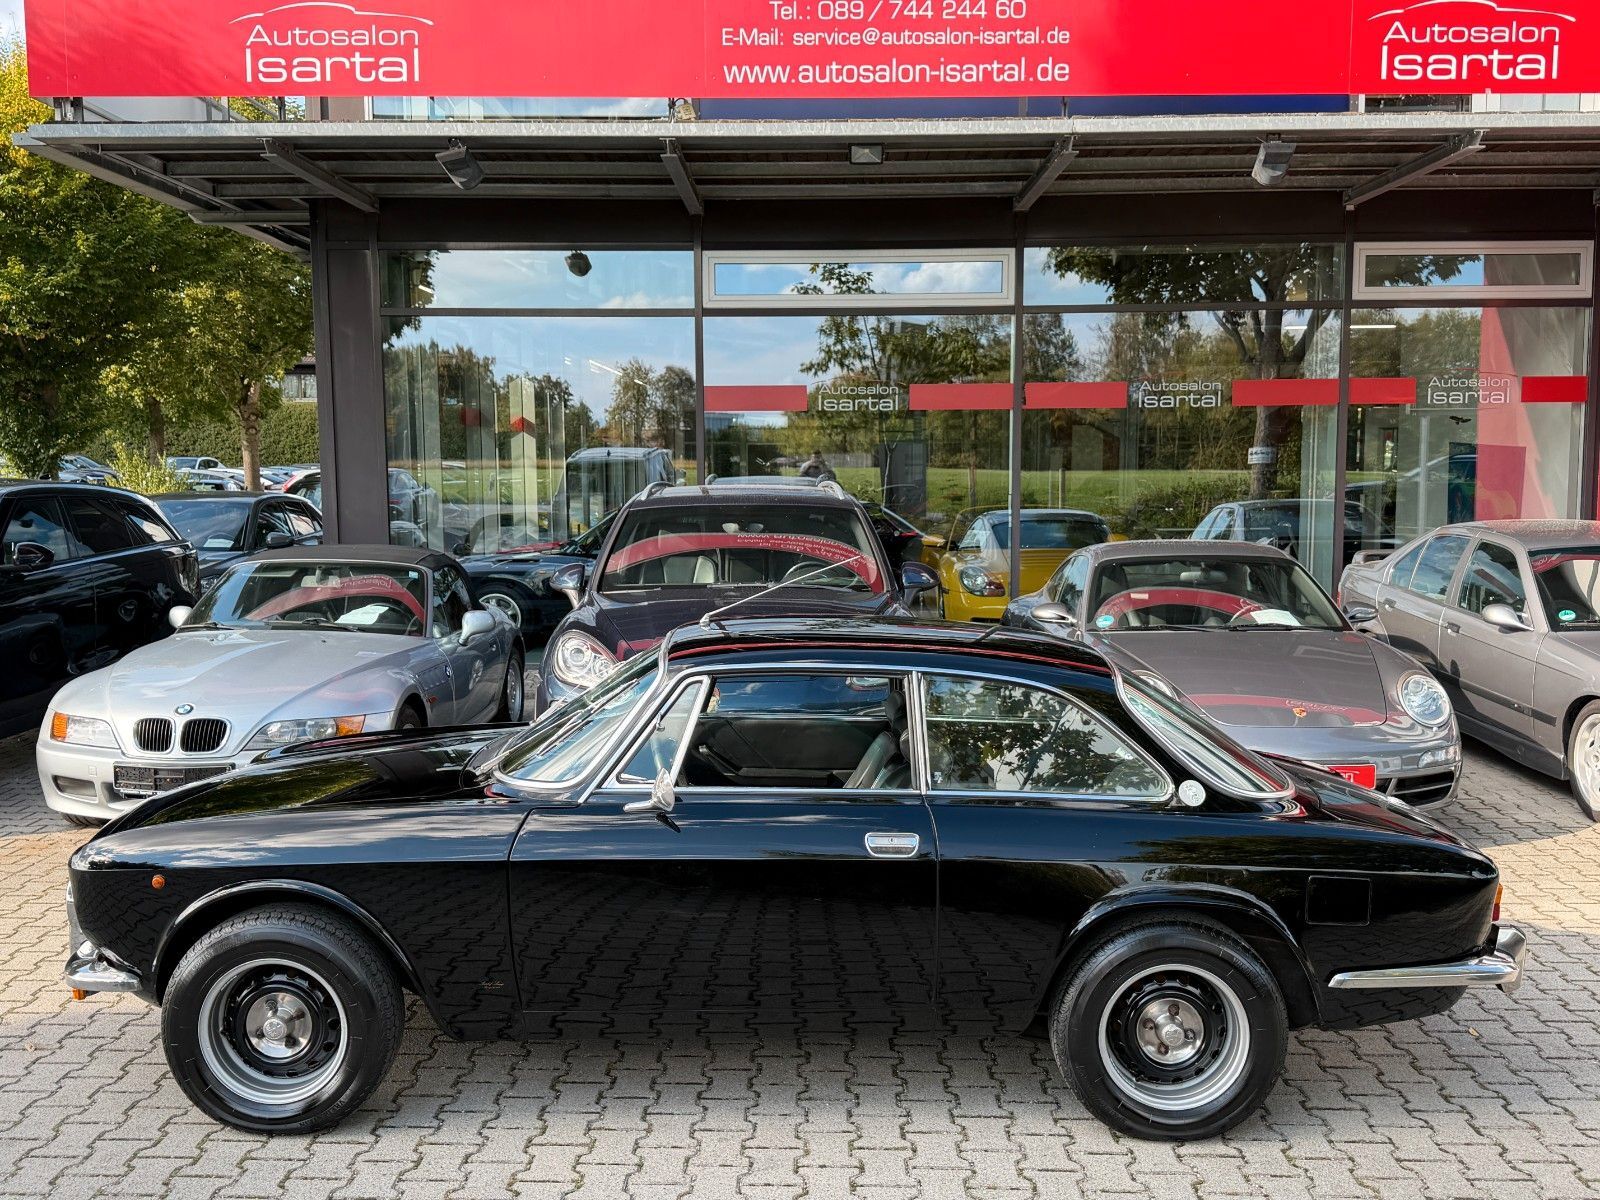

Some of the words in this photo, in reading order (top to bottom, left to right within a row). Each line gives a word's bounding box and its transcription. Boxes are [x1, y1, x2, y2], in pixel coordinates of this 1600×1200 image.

[769, 0, 811, 20] Tel.:
[817, 0, 864, 20] 089
[867, 1, 883, 22] /
[889, 0, 934, 19] 744
[942, 0, 988, 19] 244
[995, 0, 1027, 19] 60
[246, 25, 418, 46] Autosalon
[721, 28, 784, 46] E-Mail:
[792, 26, 1070, 46] service@autosalon-isartal.de
[1383, 21, 1560, 43] Autosalon
[246, 47, 420, 83] Isartal
[723, 57, 1070, 84] www.autosalon-isartal.de
[1381, 45, 1559, 80] Isartal
[818, 383, 899, 395] Autosalon
[1139, 379, 1222, 391] Autosalon
[1428, 376, 1510, 388] Autosalon
[818, 394, 899, 411] Isartal
[1138, 390, 1222, 408] Isartal
[1427, 387, 1510, 404] Isartal
